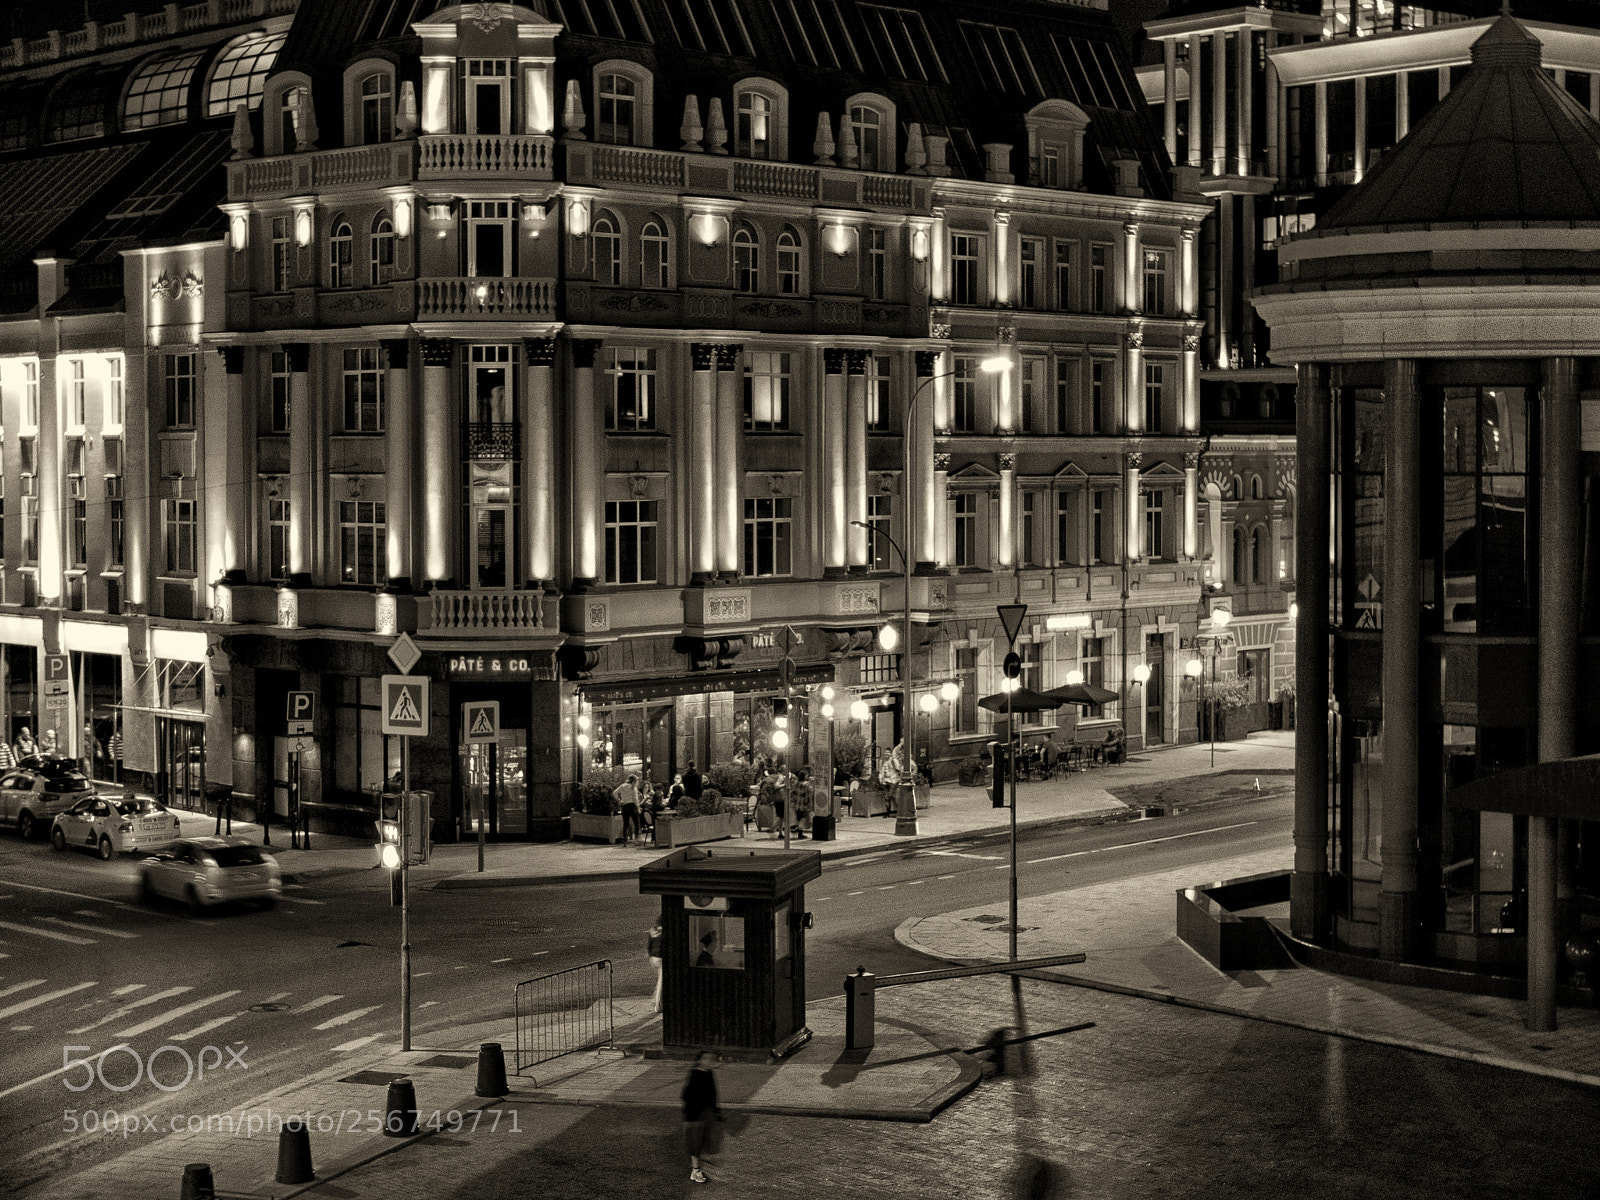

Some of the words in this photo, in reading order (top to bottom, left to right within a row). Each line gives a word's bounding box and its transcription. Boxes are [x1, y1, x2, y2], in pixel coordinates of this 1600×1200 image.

[51, 658, 64, 678] P
[450, 656, 484, 671] PÂTÉ
[492, 659, 501, 671] &
[509, 659, 531, 671] CO.
[294, 694, 310, 718] P
